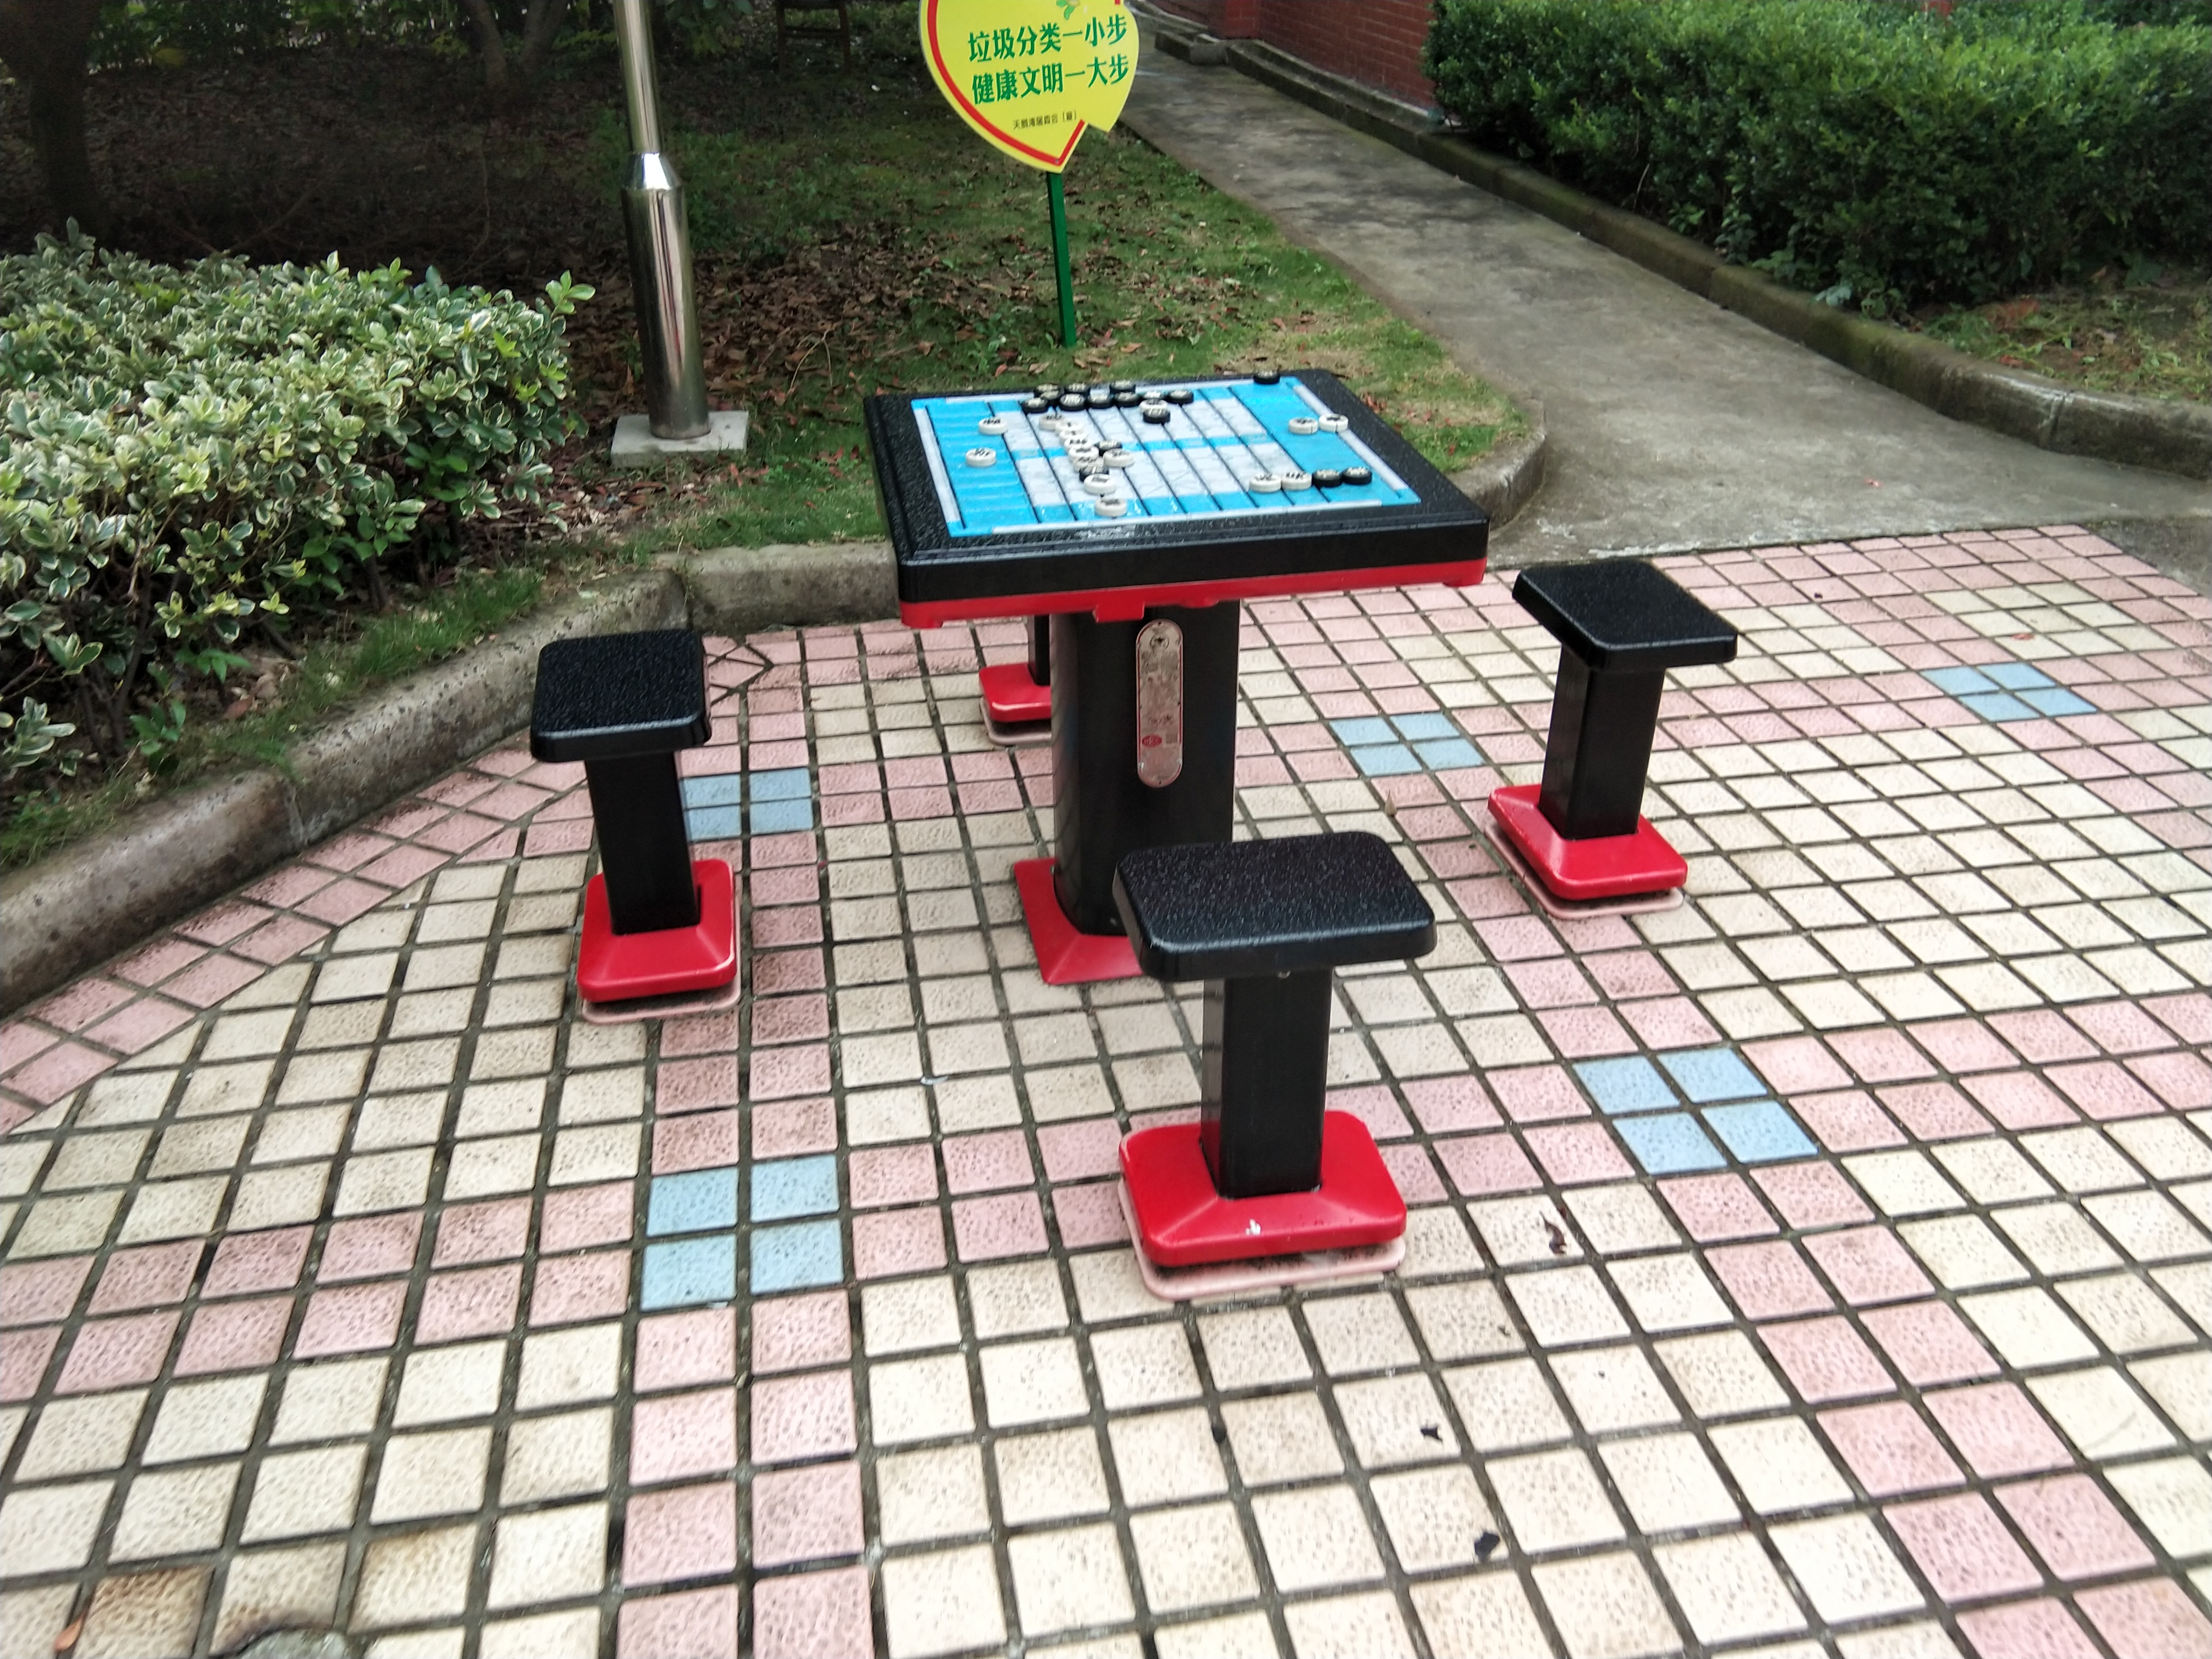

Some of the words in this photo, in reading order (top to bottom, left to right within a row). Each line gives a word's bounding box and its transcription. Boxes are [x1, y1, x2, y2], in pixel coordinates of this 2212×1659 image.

[968, 14, 1127, 62] 垃圾分类一小步
[972, 53, 1129, 105] 健康文明一大步
